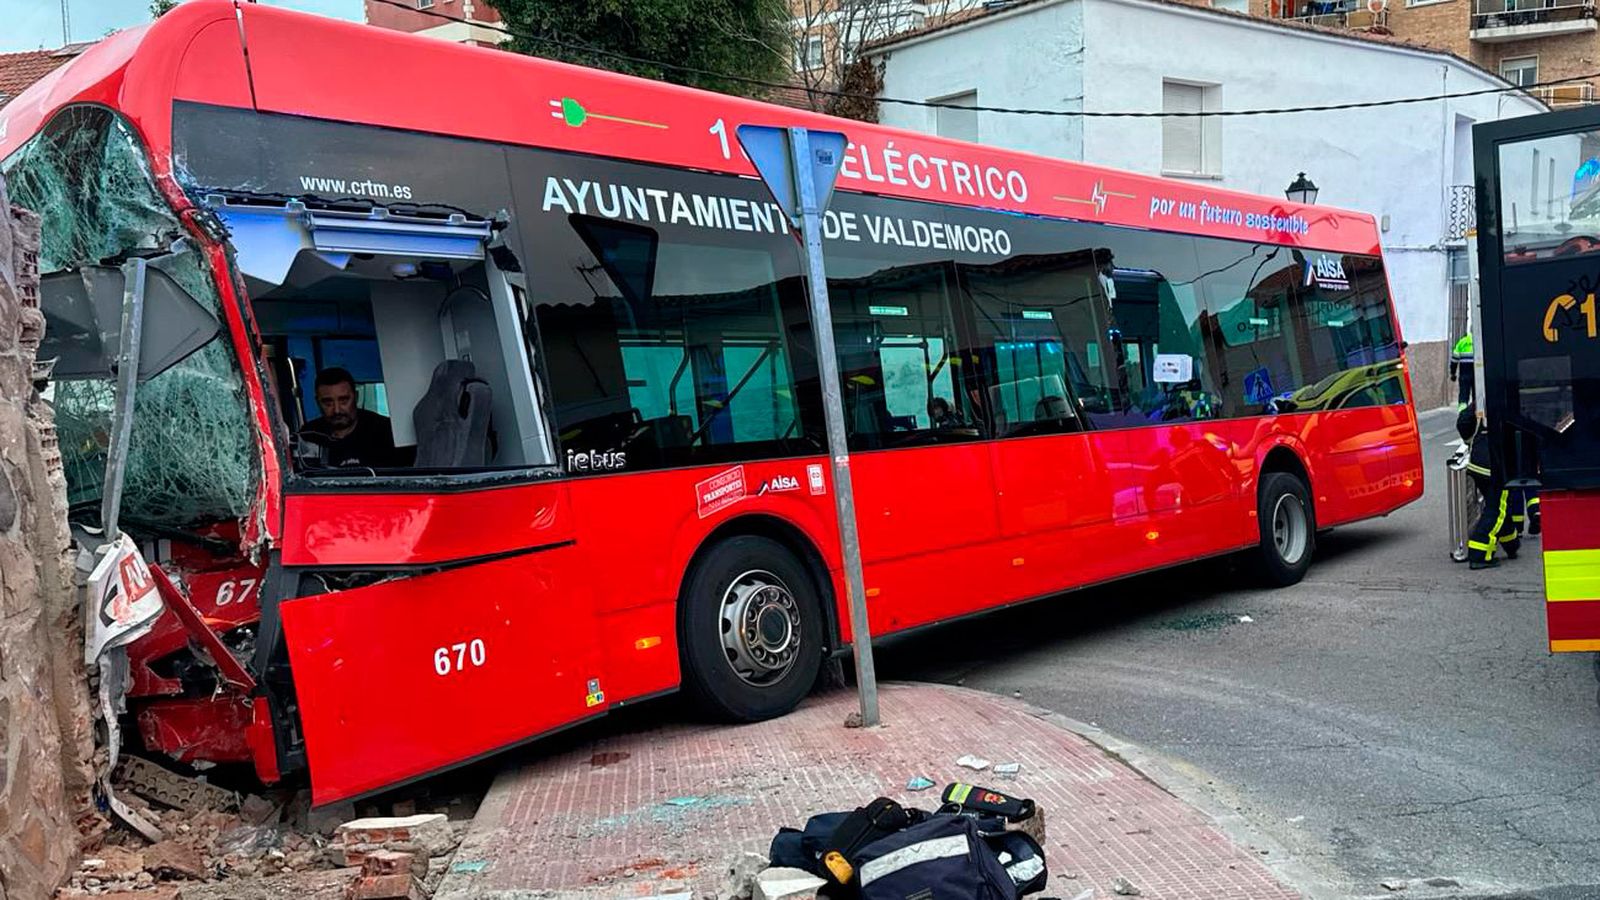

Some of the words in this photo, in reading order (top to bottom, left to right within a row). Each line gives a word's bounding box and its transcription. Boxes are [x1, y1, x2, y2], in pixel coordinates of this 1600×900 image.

[299, 175, 413, 199] www.crtm.es
[840, 141, 1029, 203] ELÉCTRICO
[541, 176, 791, 235] AYUNTAMIENT
[824, 210, 861, 241] DE
[863, 214, 1011, 256] VALDEMORO
[1150, 197, 1175, 219] por
[1179, 201, 1196, 220] un
[1200, 200, 1242, 226] futuro
[1245, 213, 1309, 235] sostenible
[433, 638, 486, 676] 670
